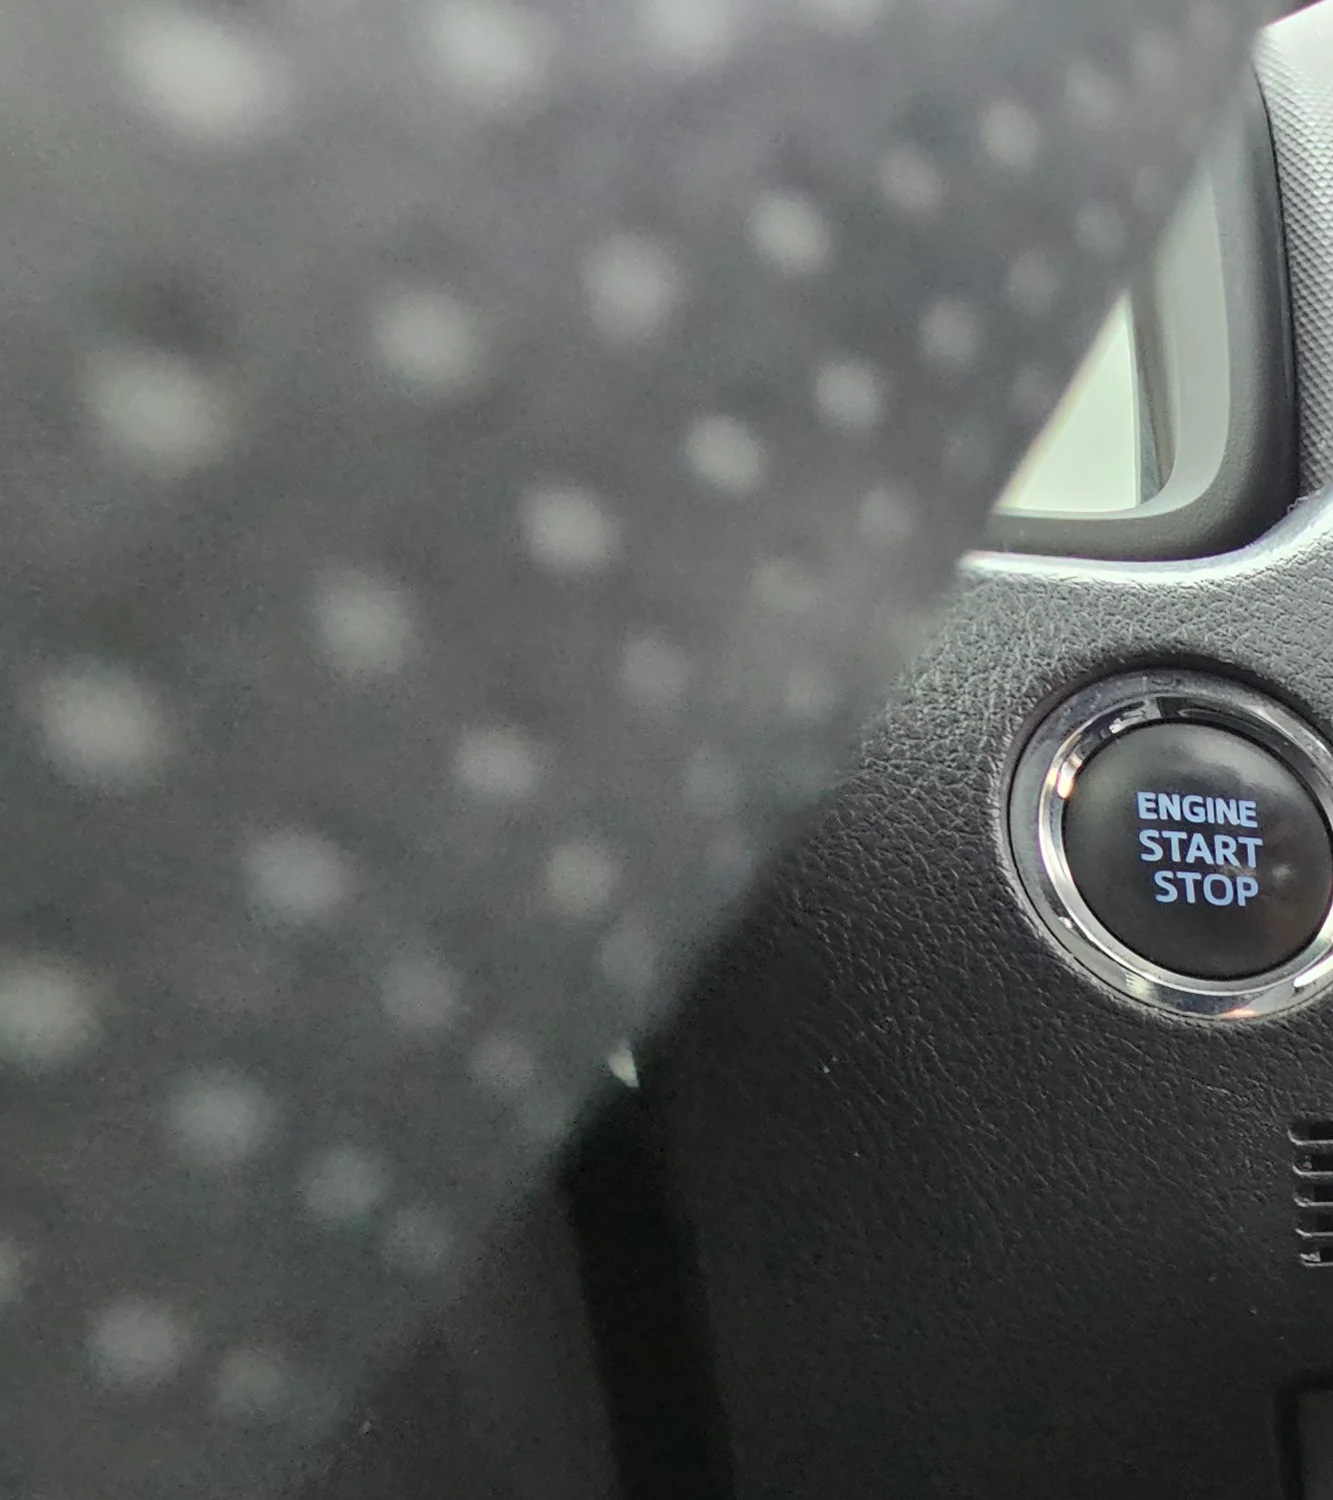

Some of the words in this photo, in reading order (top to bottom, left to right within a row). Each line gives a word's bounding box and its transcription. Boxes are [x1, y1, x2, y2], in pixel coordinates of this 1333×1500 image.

[1137, 790, 1258, 828] ENGINE
[1138, 829, 1263, 868] START
[1154, 870, 1259, 907] STOP
